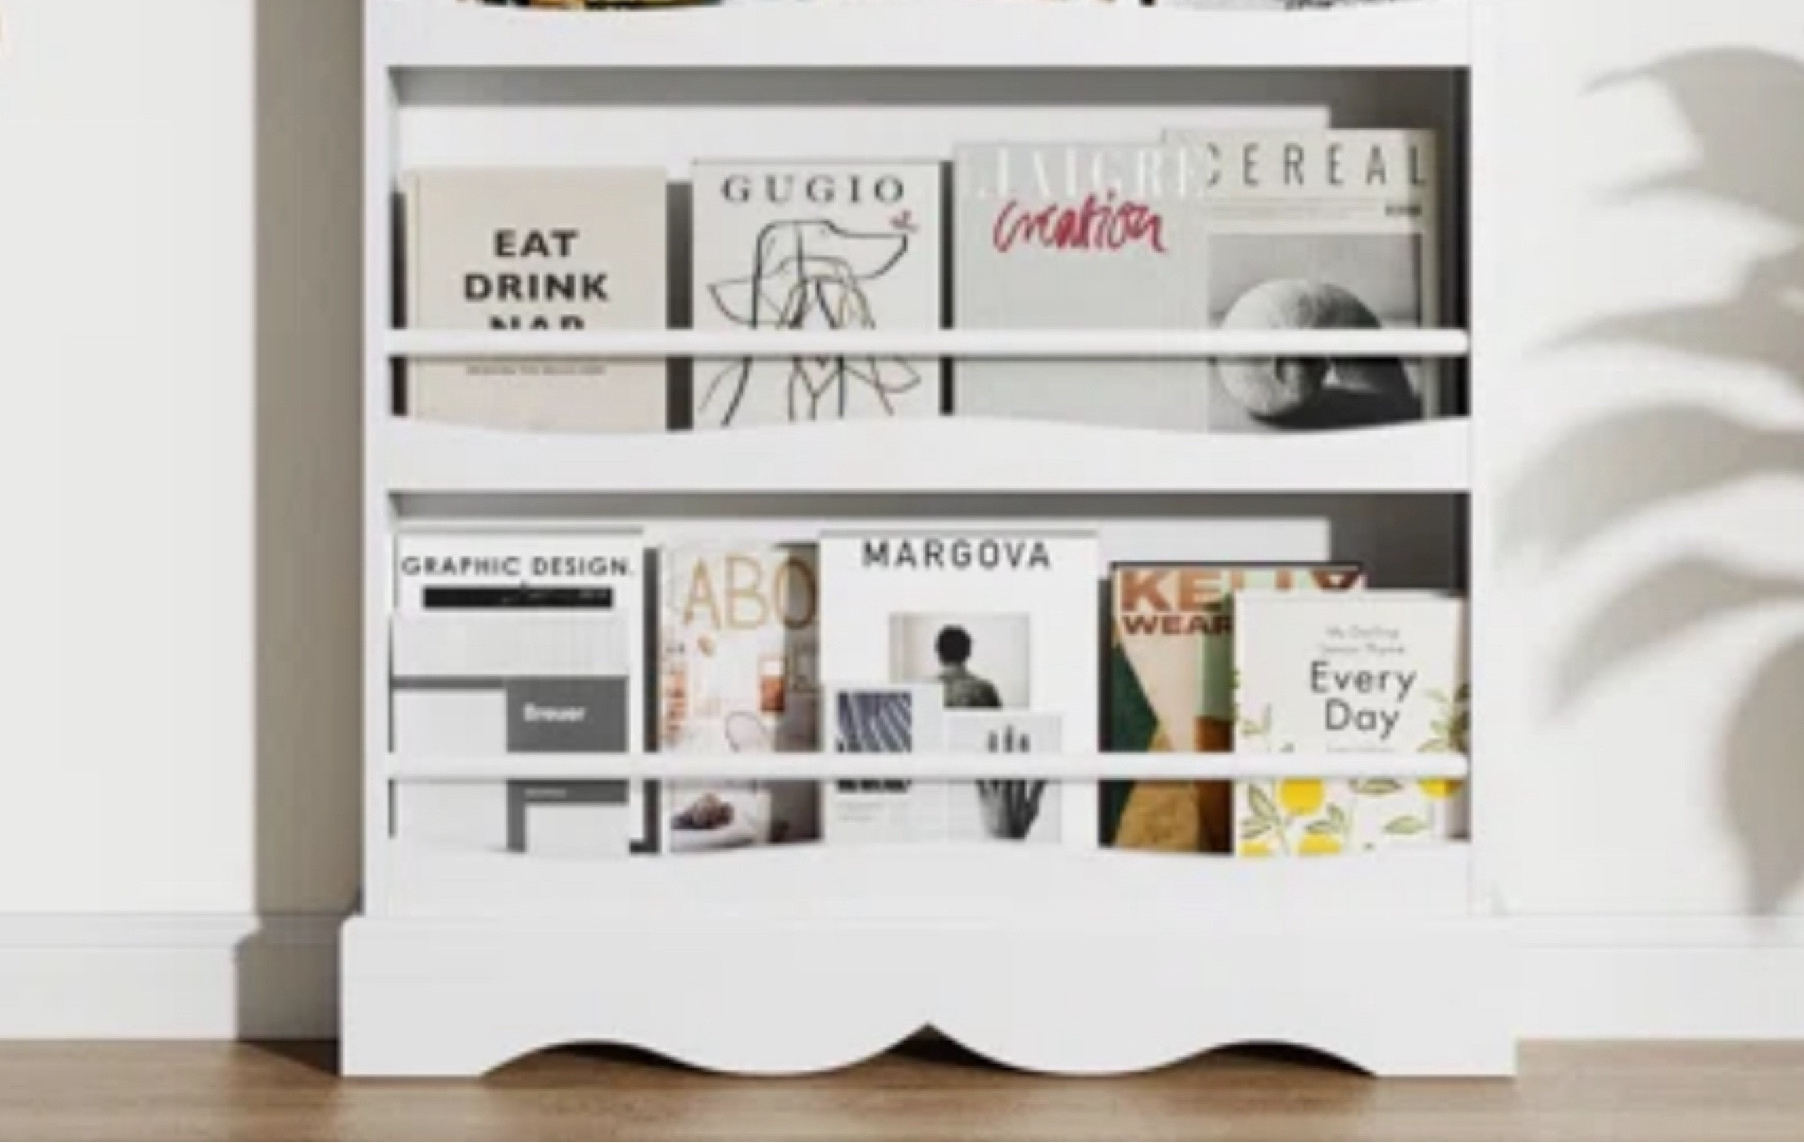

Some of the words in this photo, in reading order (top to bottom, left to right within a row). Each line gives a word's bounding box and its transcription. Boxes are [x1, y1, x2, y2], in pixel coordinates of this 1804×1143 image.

[721, 175, 905, 204] GUGIO
[494, 230, 579, 258] EAT
[464, 273, 609, 301] DRINK
[401, 556, 522, 577] GRAPHIC
[863, 540, 1050, 568] MARGOVA
[1122, 616, 1233, 635] WEAR
[1310, 660, 1417, 703] Every
[523, 703, 586, 722] Breuer
[1325, 698, 1400, 739] Day
